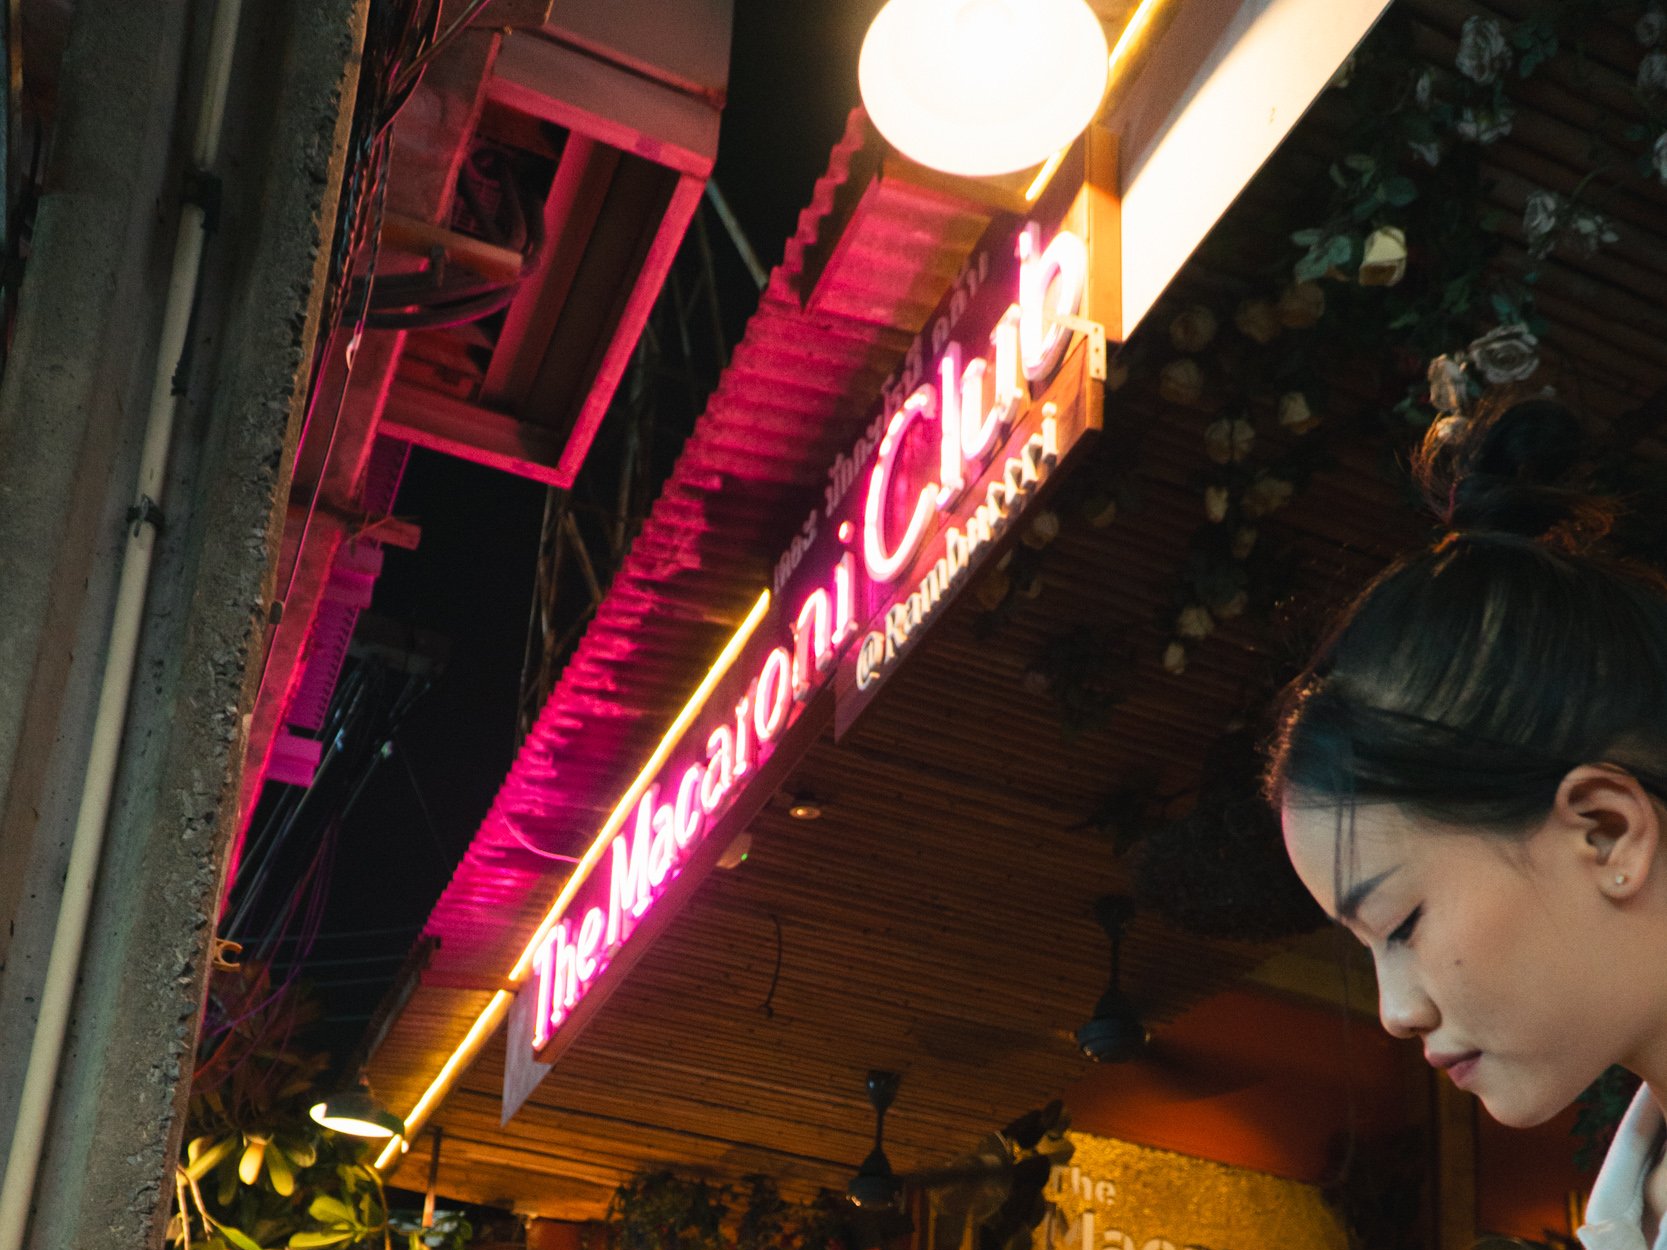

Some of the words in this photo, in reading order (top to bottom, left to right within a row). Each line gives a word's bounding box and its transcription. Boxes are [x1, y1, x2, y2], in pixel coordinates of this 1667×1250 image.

[531, 905, 608, 1051] The
[606, 520, 859, 946] Macaroni
[862, 222, 1089, 583] Club
